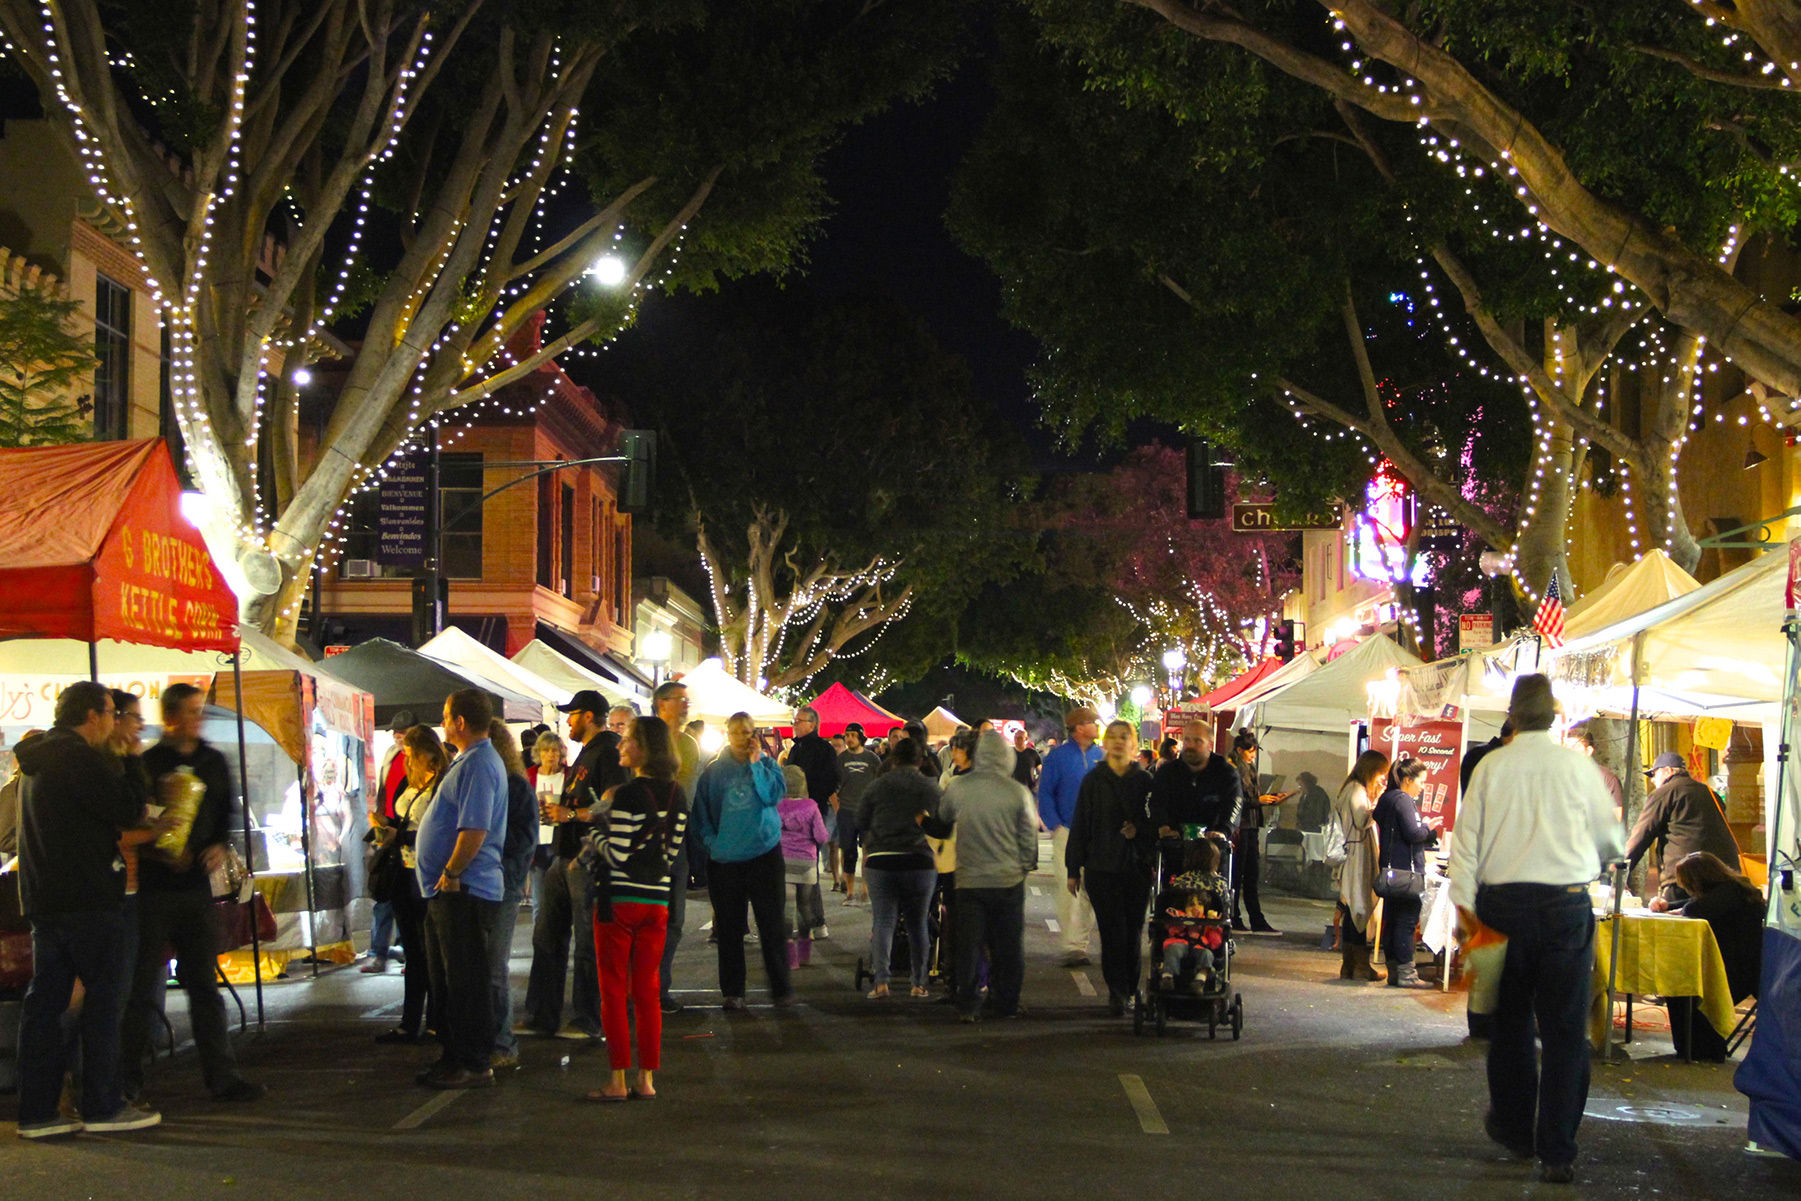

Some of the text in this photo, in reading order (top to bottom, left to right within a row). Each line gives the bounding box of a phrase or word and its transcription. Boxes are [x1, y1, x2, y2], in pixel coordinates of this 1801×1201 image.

[381, 544, 423, 554] Welcome
[121, 581, 183, 640] KETTLE
[1417, 731, 1442, 744] Fast
[1418, 746, 1455, 756] 10 Second
